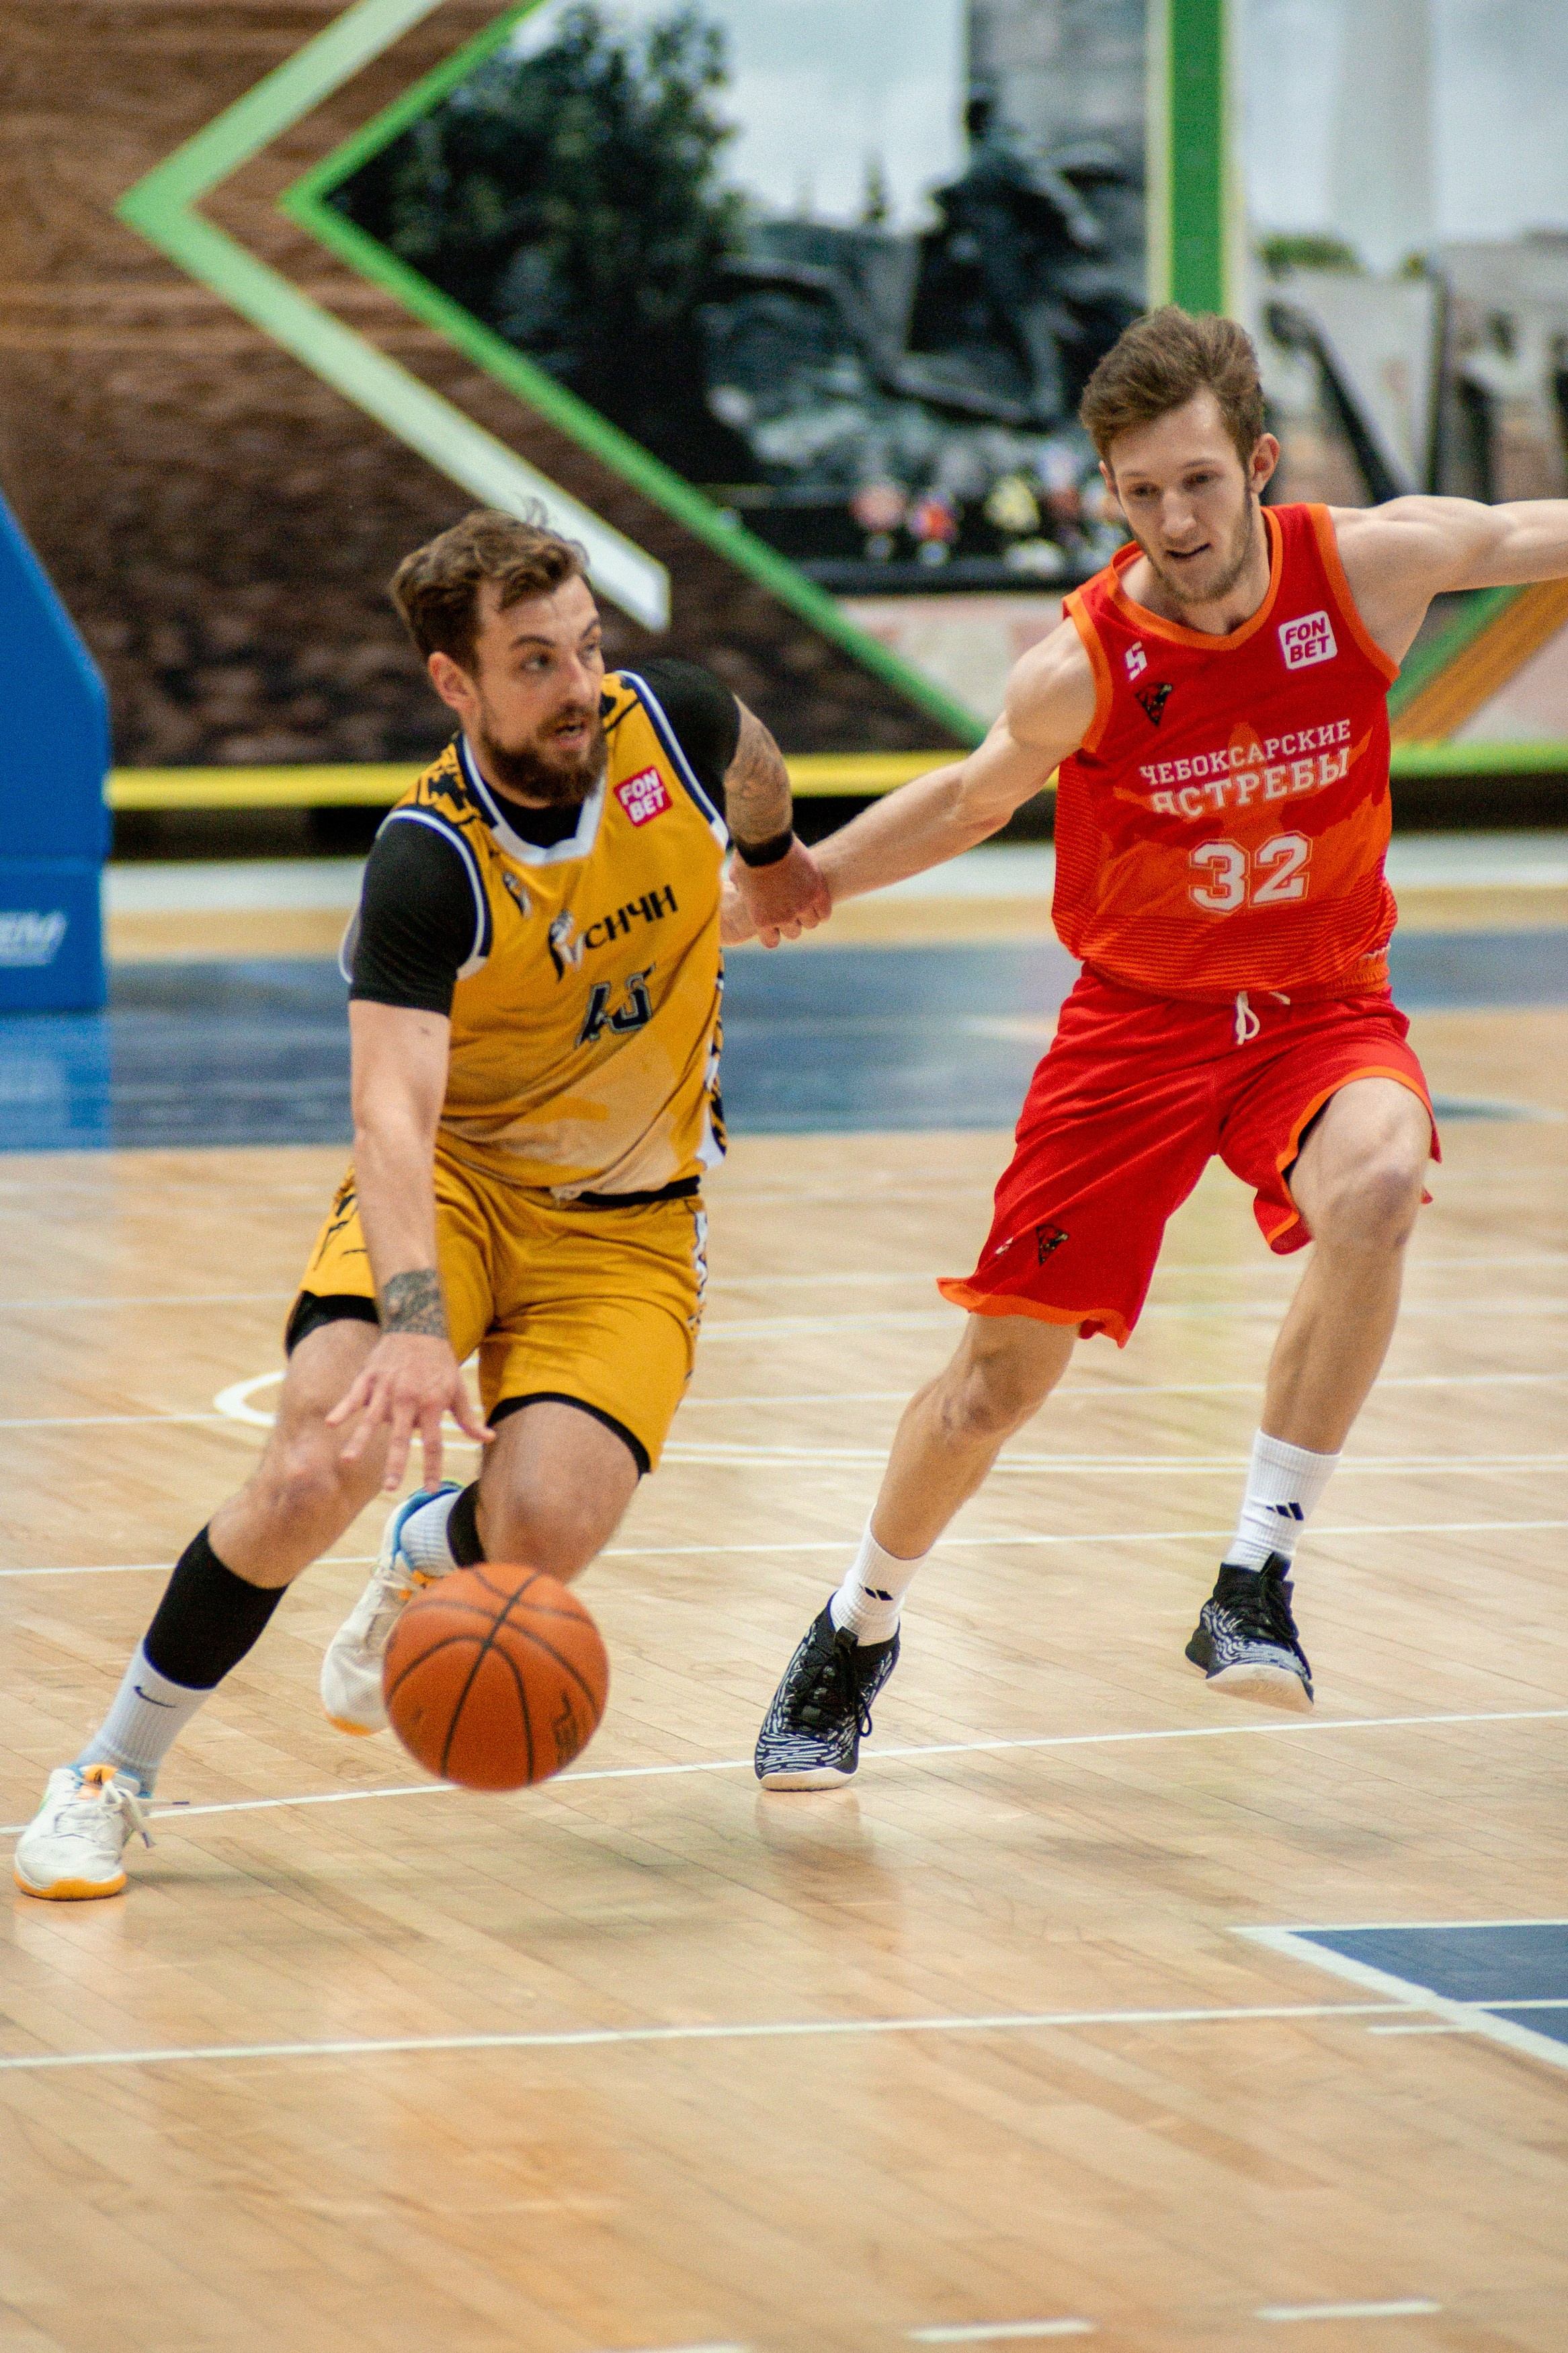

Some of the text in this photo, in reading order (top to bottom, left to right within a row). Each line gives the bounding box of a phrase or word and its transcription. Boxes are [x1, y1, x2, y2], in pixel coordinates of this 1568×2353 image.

[1285, 616, 1325, 645] FON
[1290, 635, 1330, 663] BET
[1139, 719, 1351, 786] ЧЕБОКСАРСКИЕ
[620, 768, 659, 805] FON
[1151, 746, 1351, 817] ЯСТРЕБЫ
[629, 786, 664, 823] BET
[1189, 830, 1313, 916] 32
